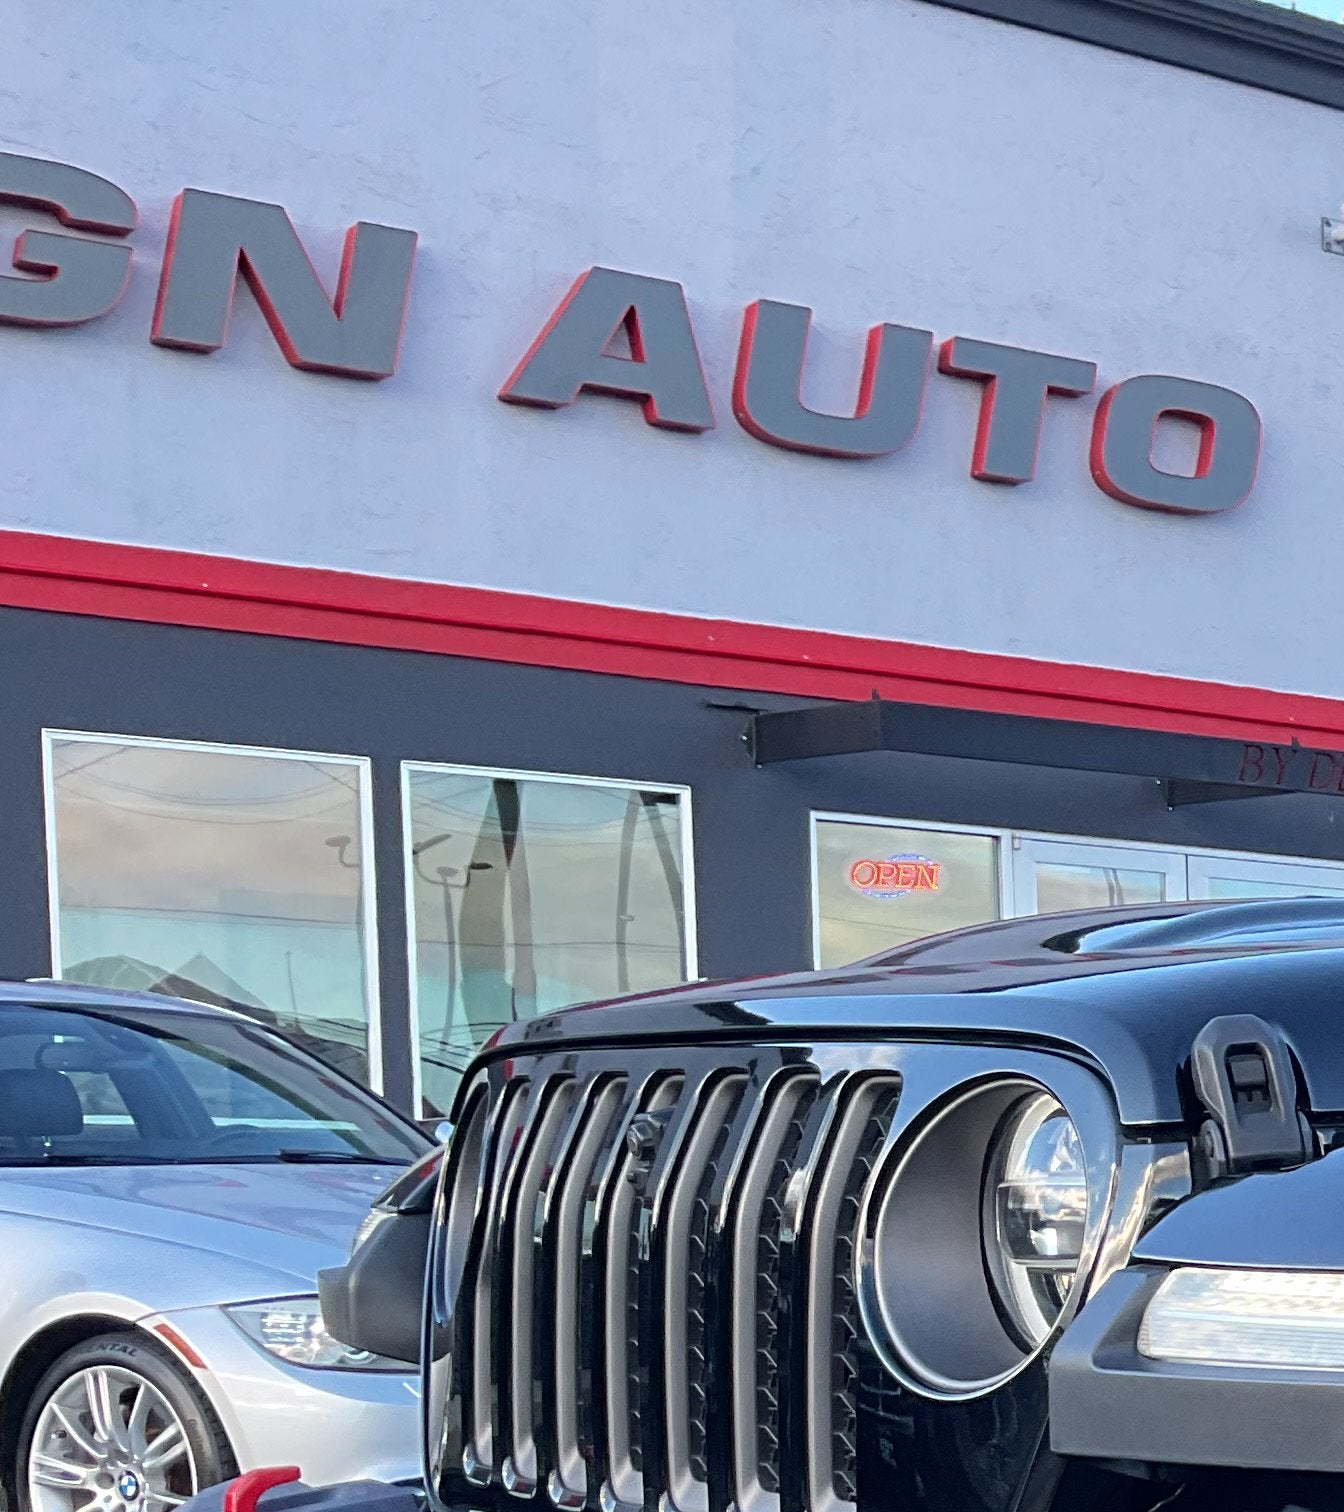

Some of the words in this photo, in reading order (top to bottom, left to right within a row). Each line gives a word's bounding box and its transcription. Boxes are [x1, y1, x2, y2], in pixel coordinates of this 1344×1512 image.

[498, 266, 1262, 515] AUTO
[1238, 743, 1297, 786] BY
[851, 860, 941, 890] OPEN
